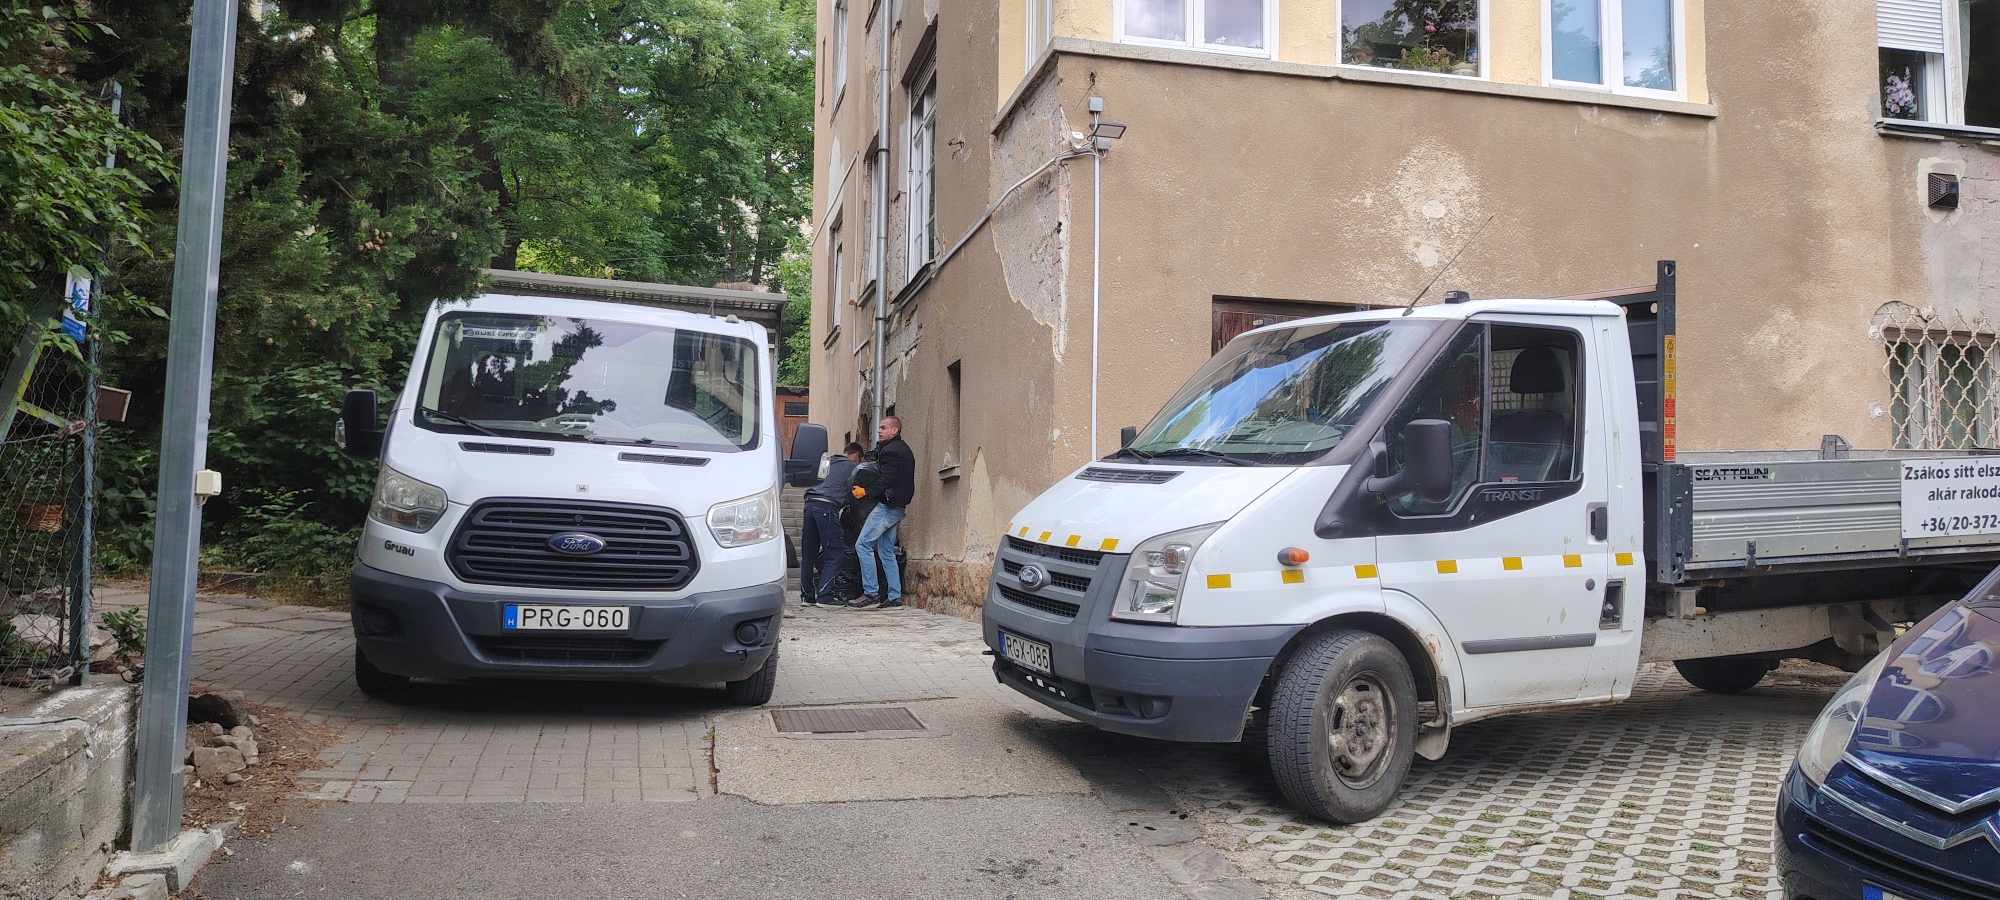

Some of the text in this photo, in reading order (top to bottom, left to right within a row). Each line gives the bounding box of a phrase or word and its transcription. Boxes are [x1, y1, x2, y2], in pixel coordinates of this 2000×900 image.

[1695, 468, 1769, 480] SCATTOLINI
[1904, 465, 1950, 480] Zsákos
[1954, 464, 1975, 478] sitt
[1480, 490, 1544, 502] TRANSIT
[1928, 486, 1957, 501] akár
[384, 539, 415, 556] Gruau
[560, 537, 592, 551] Ford
[522, 608, 624, 628] PRG-060
[1005, 635, 1049, 669] RGX-086
